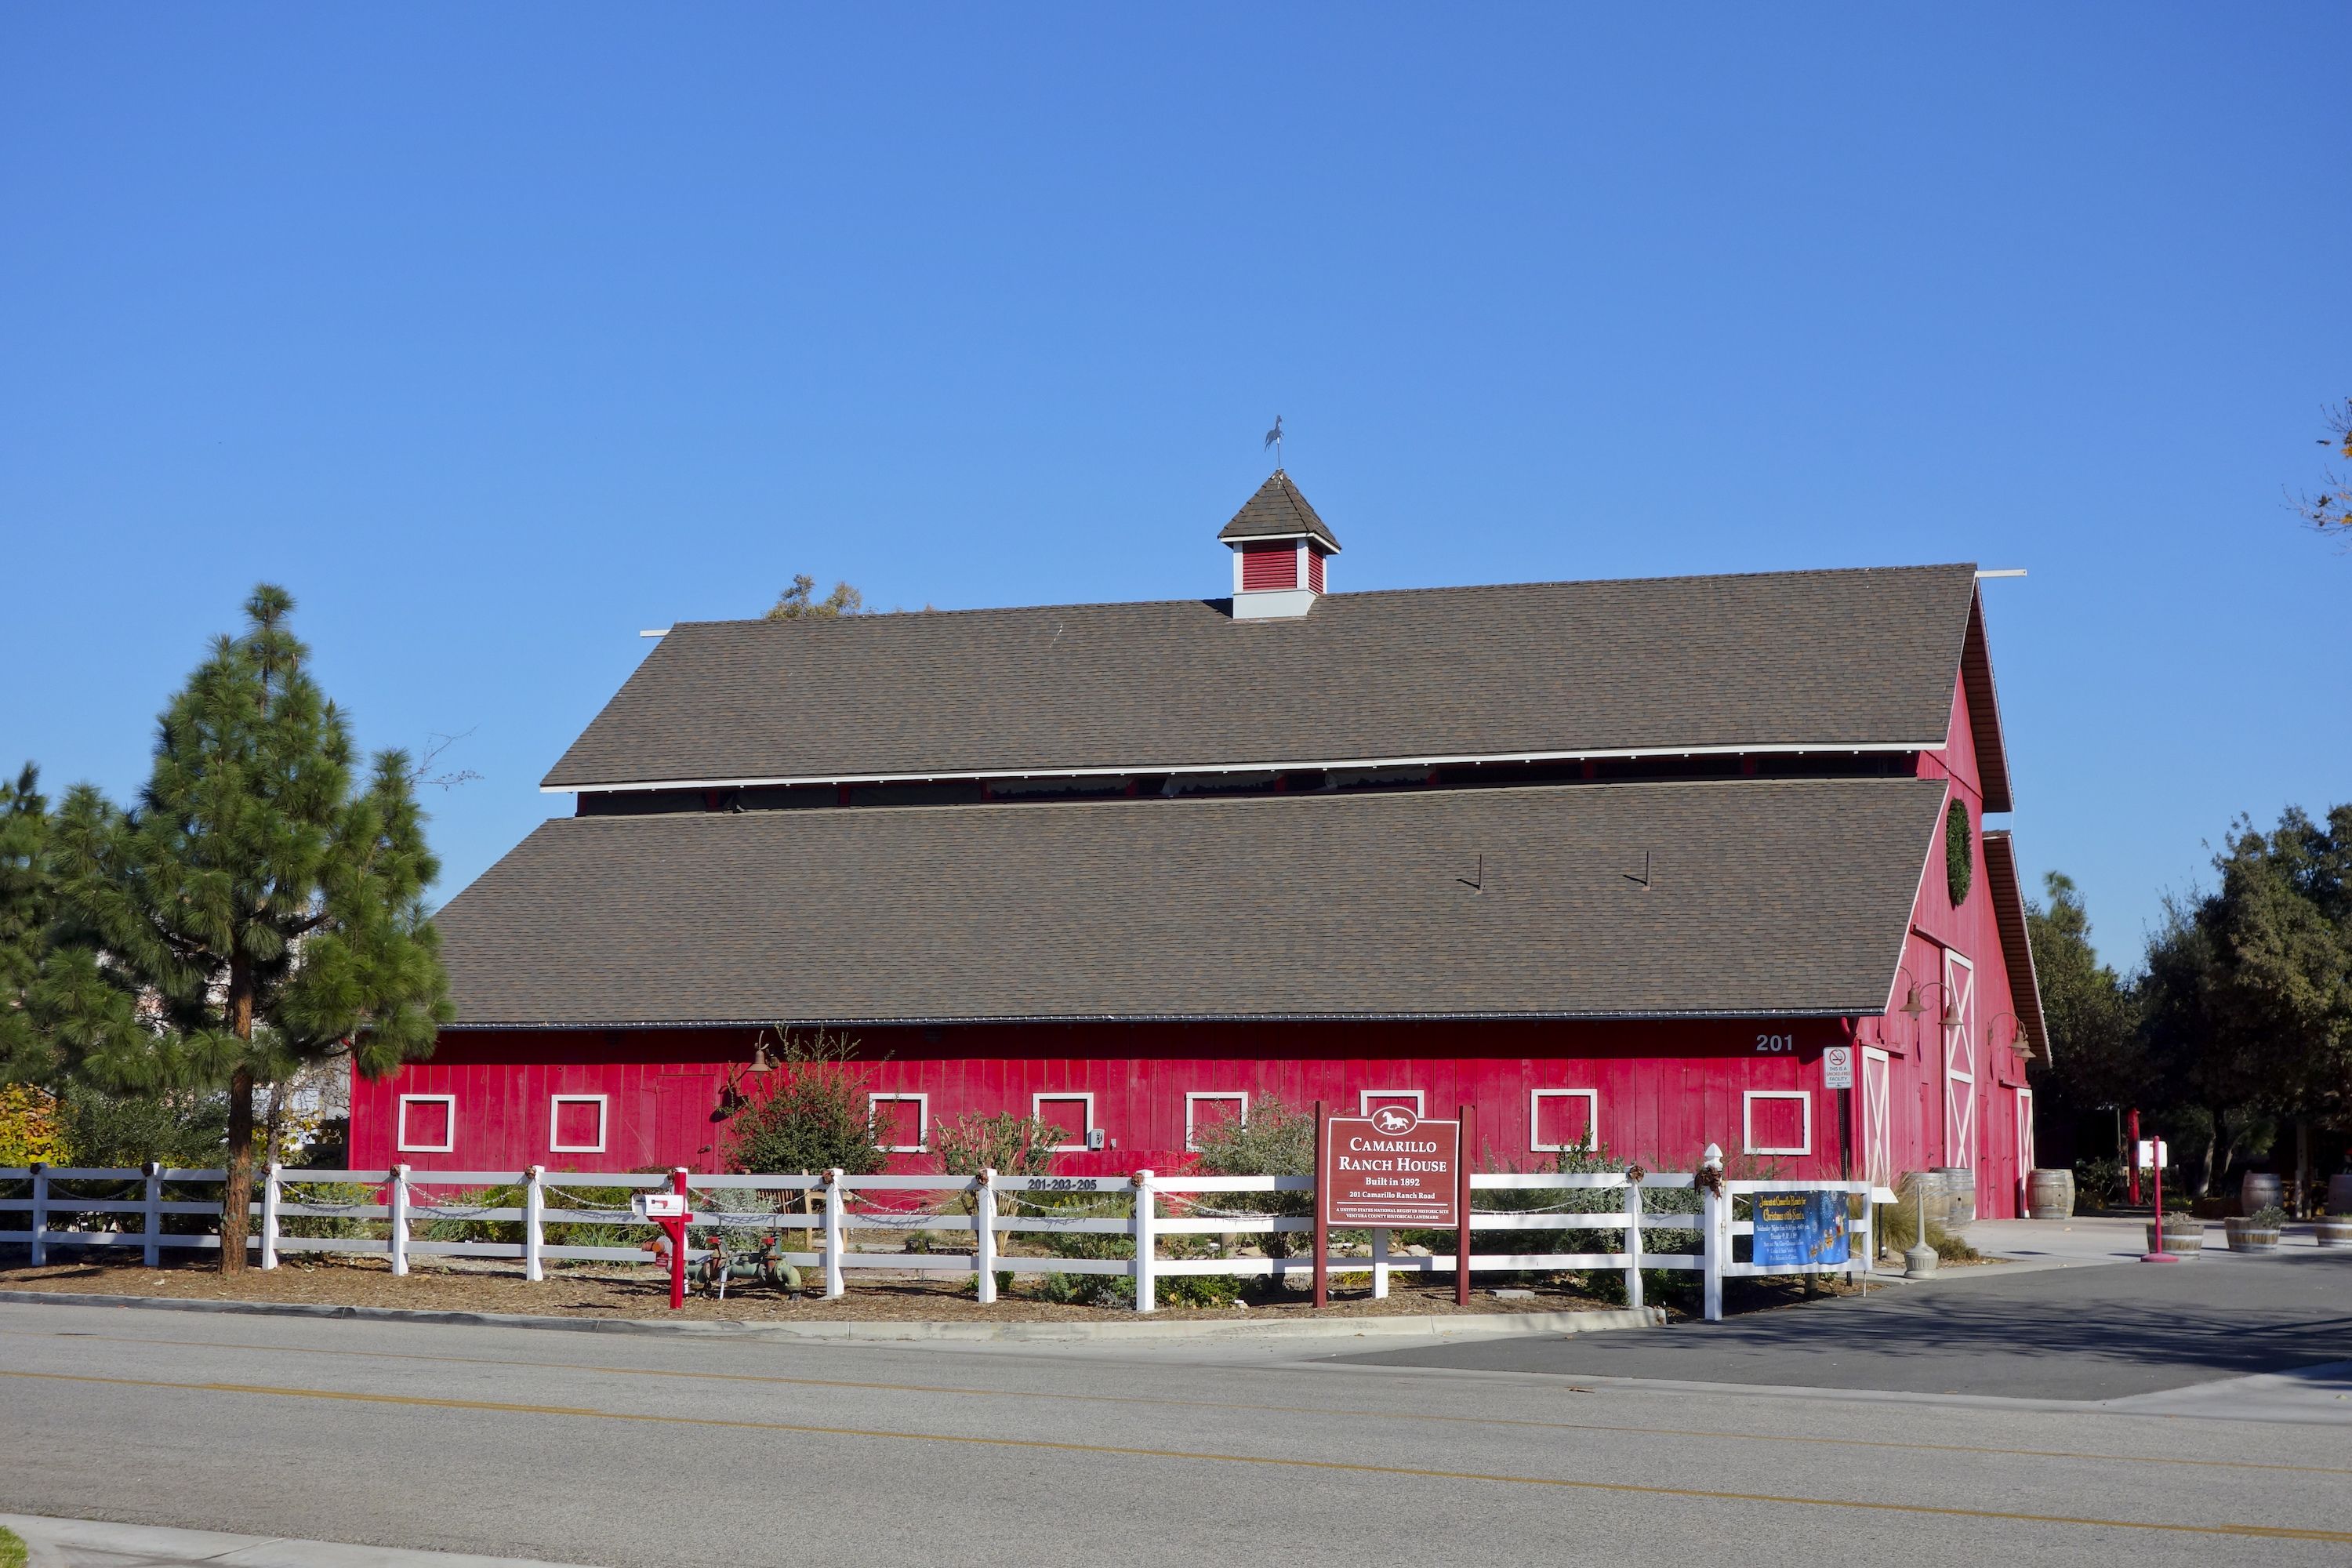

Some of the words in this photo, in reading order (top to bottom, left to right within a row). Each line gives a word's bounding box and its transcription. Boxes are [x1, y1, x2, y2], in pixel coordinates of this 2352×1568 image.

[1756, 1035, 1792, 1052] 201
[1349, 1137, 1437, 1153] CAMARILLO
[1339, 1156, 1392, 1171] RANCH
[1397, 1157, 1447, 1173] HOUSE
[1028, 1179, 1097, 1190] 201-203-205
[1366, 1177, 1388, 1185] Built
[1389, 1178, 1399, 1186] in
[1400, 1178, 1421, 1187] 1892
